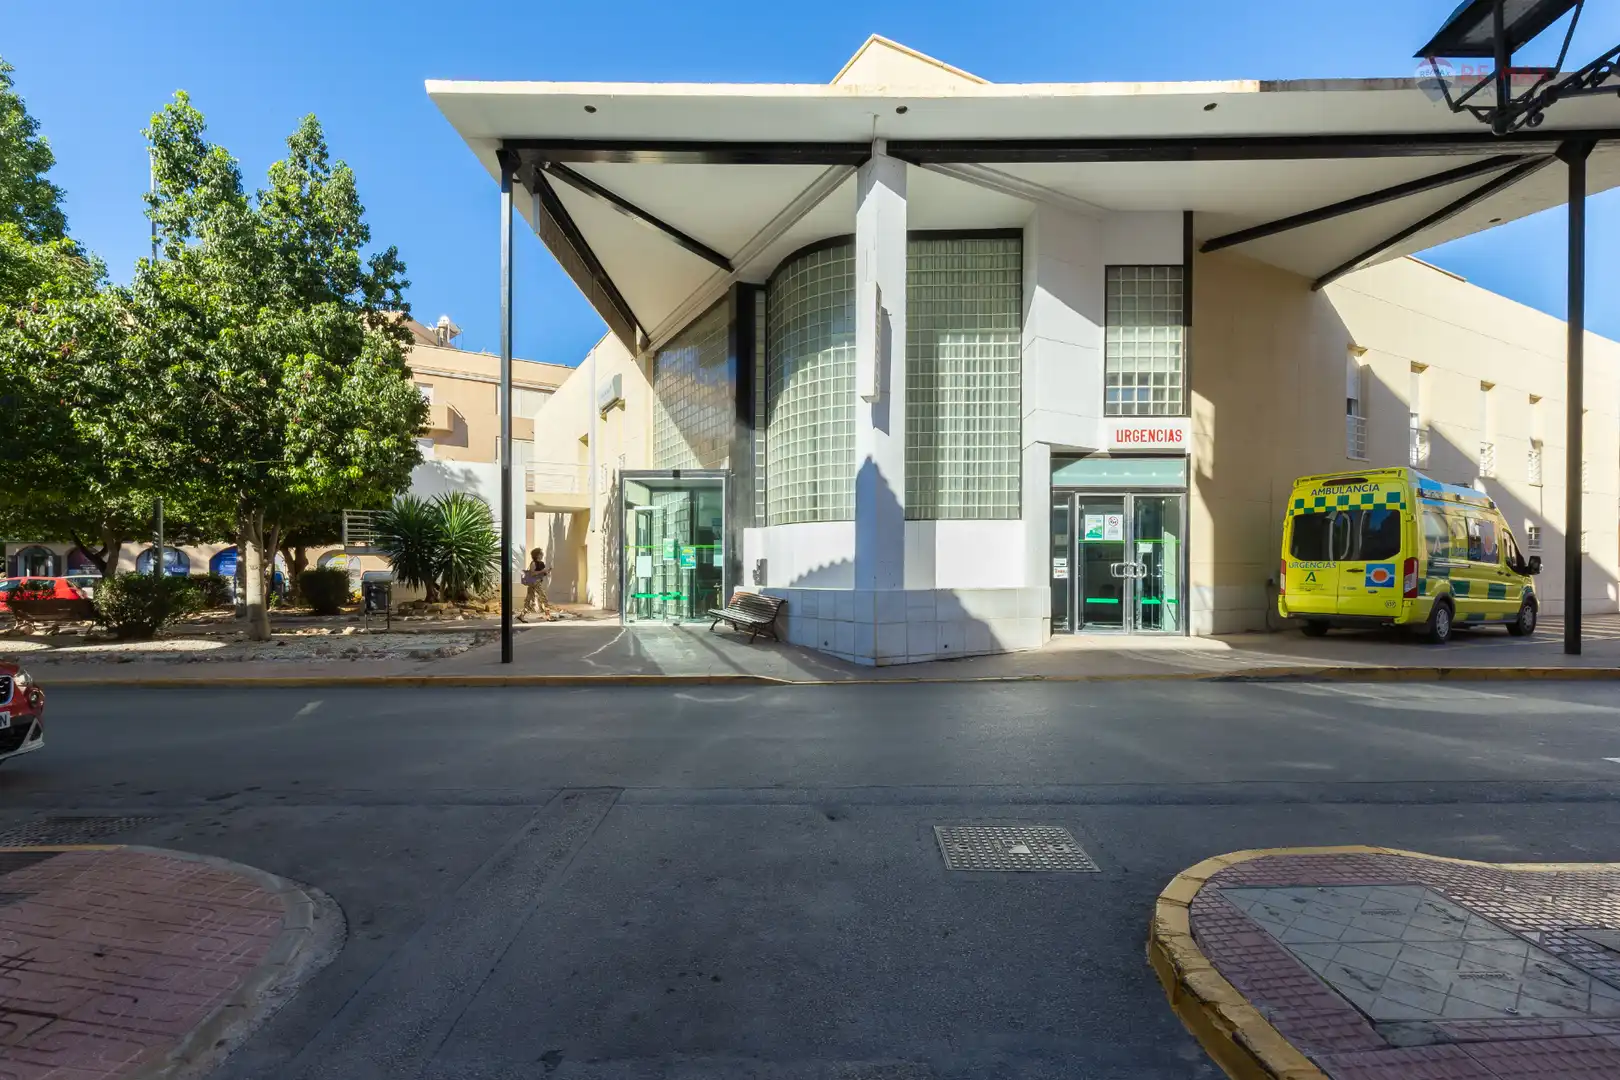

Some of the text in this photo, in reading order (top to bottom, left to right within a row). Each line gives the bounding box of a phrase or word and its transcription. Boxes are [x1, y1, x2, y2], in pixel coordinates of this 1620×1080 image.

[1116, 429, 1183, 443] URGENCIAS
[1310, 483, 1380, 497] AMBULANCIA
[1288, 561, 1337, 569] URGENCIAS
